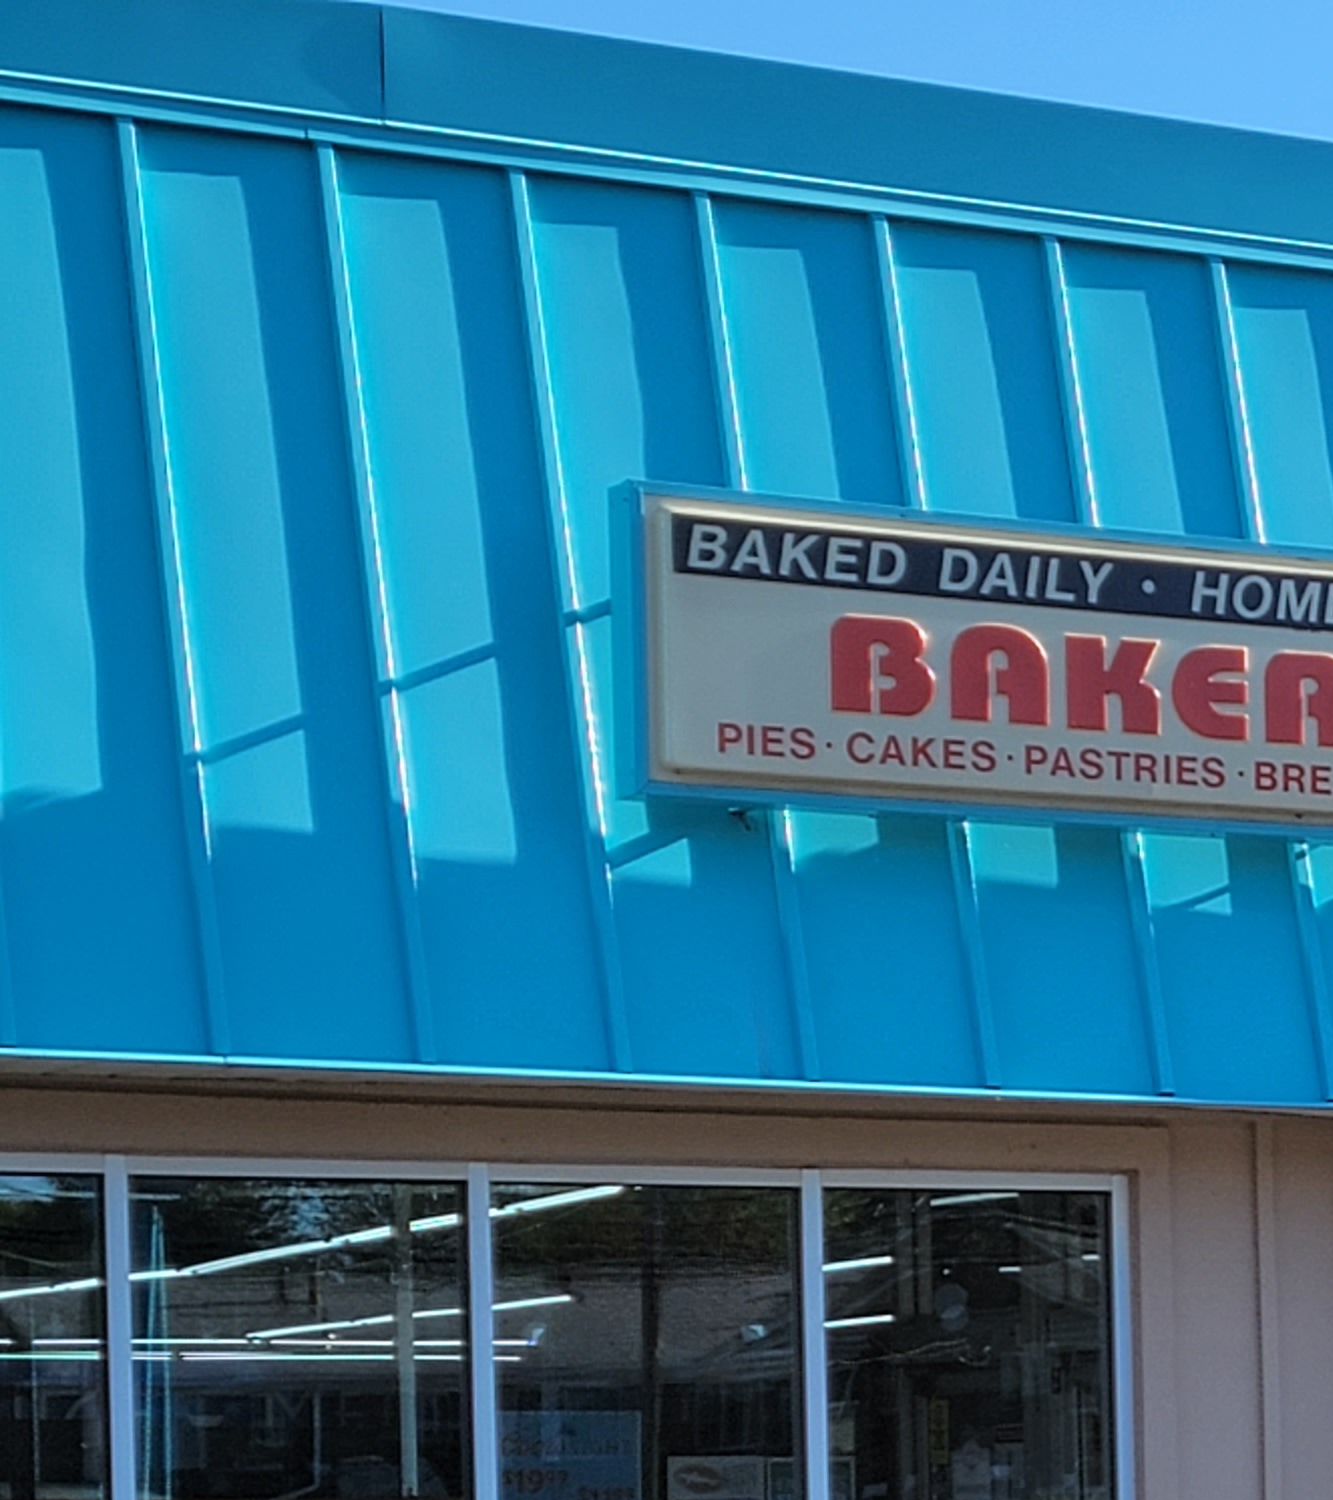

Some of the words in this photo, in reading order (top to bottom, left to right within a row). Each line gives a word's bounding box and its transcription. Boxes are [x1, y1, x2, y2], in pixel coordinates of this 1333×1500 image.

[687, 523, 908, 588] BAKED
[938, 547, 1113, 605] DAILY
[717, 722, 817, 761] PIES
[845, 731, 996, 775] CAKES
[1024, 745, 1226, 790] PASTRIES
